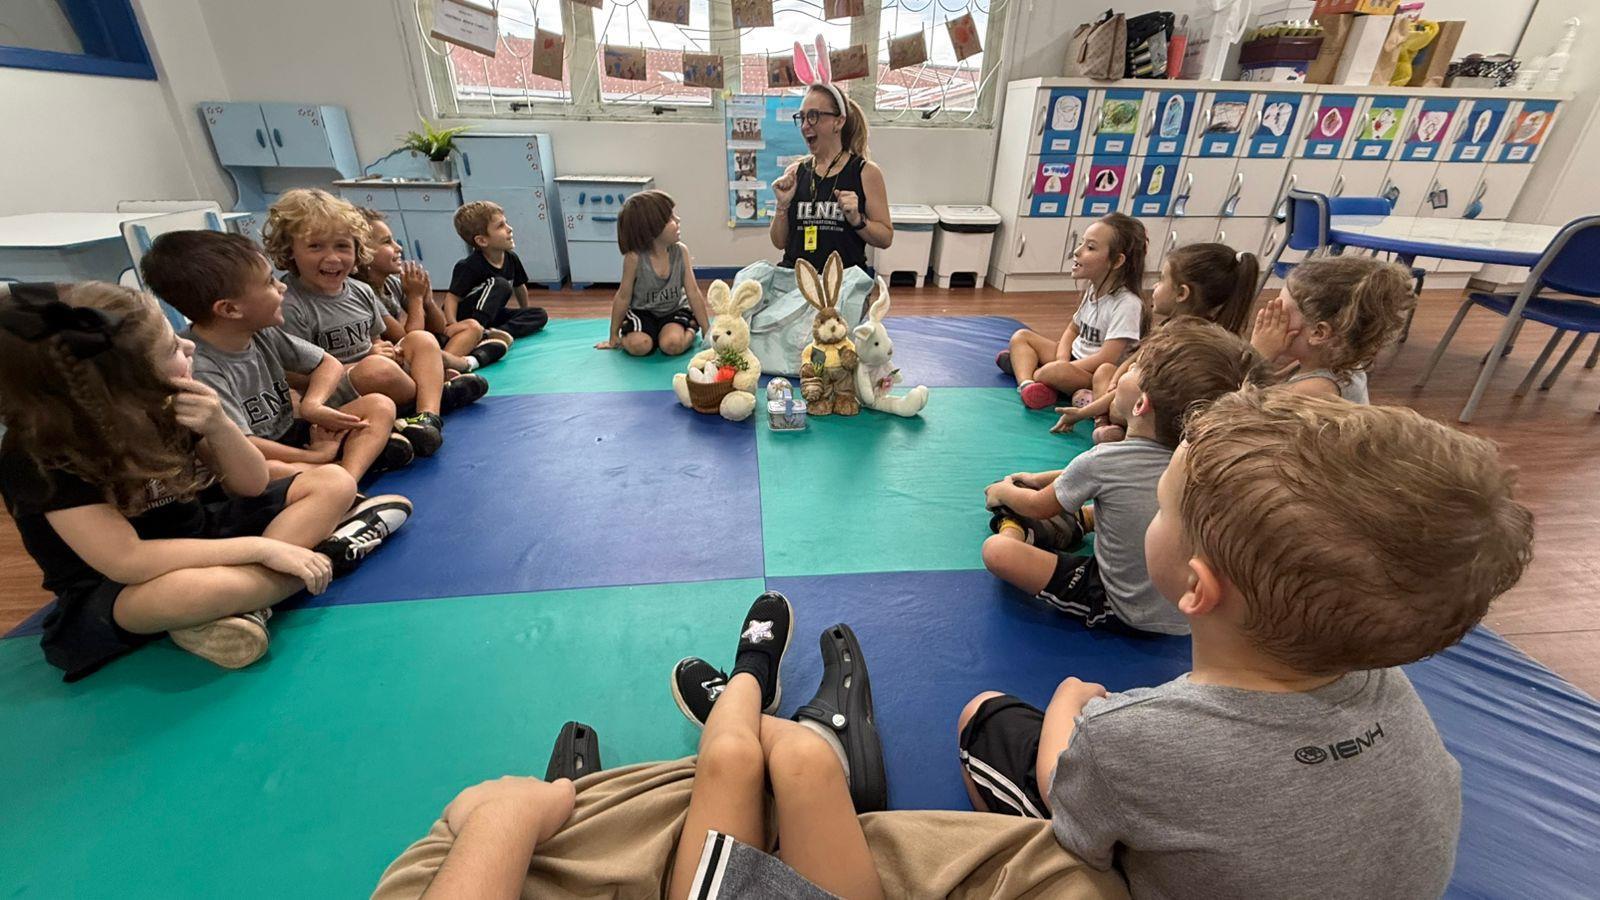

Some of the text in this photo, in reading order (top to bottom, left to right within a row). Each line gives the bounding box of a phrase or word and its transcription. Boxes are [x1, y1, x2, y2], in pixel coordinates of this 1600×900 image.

[797, 201, 845, 221] IENH
[1080, 321, 1101, 343] NH
[1328, 722, 1384, 760] IENH
